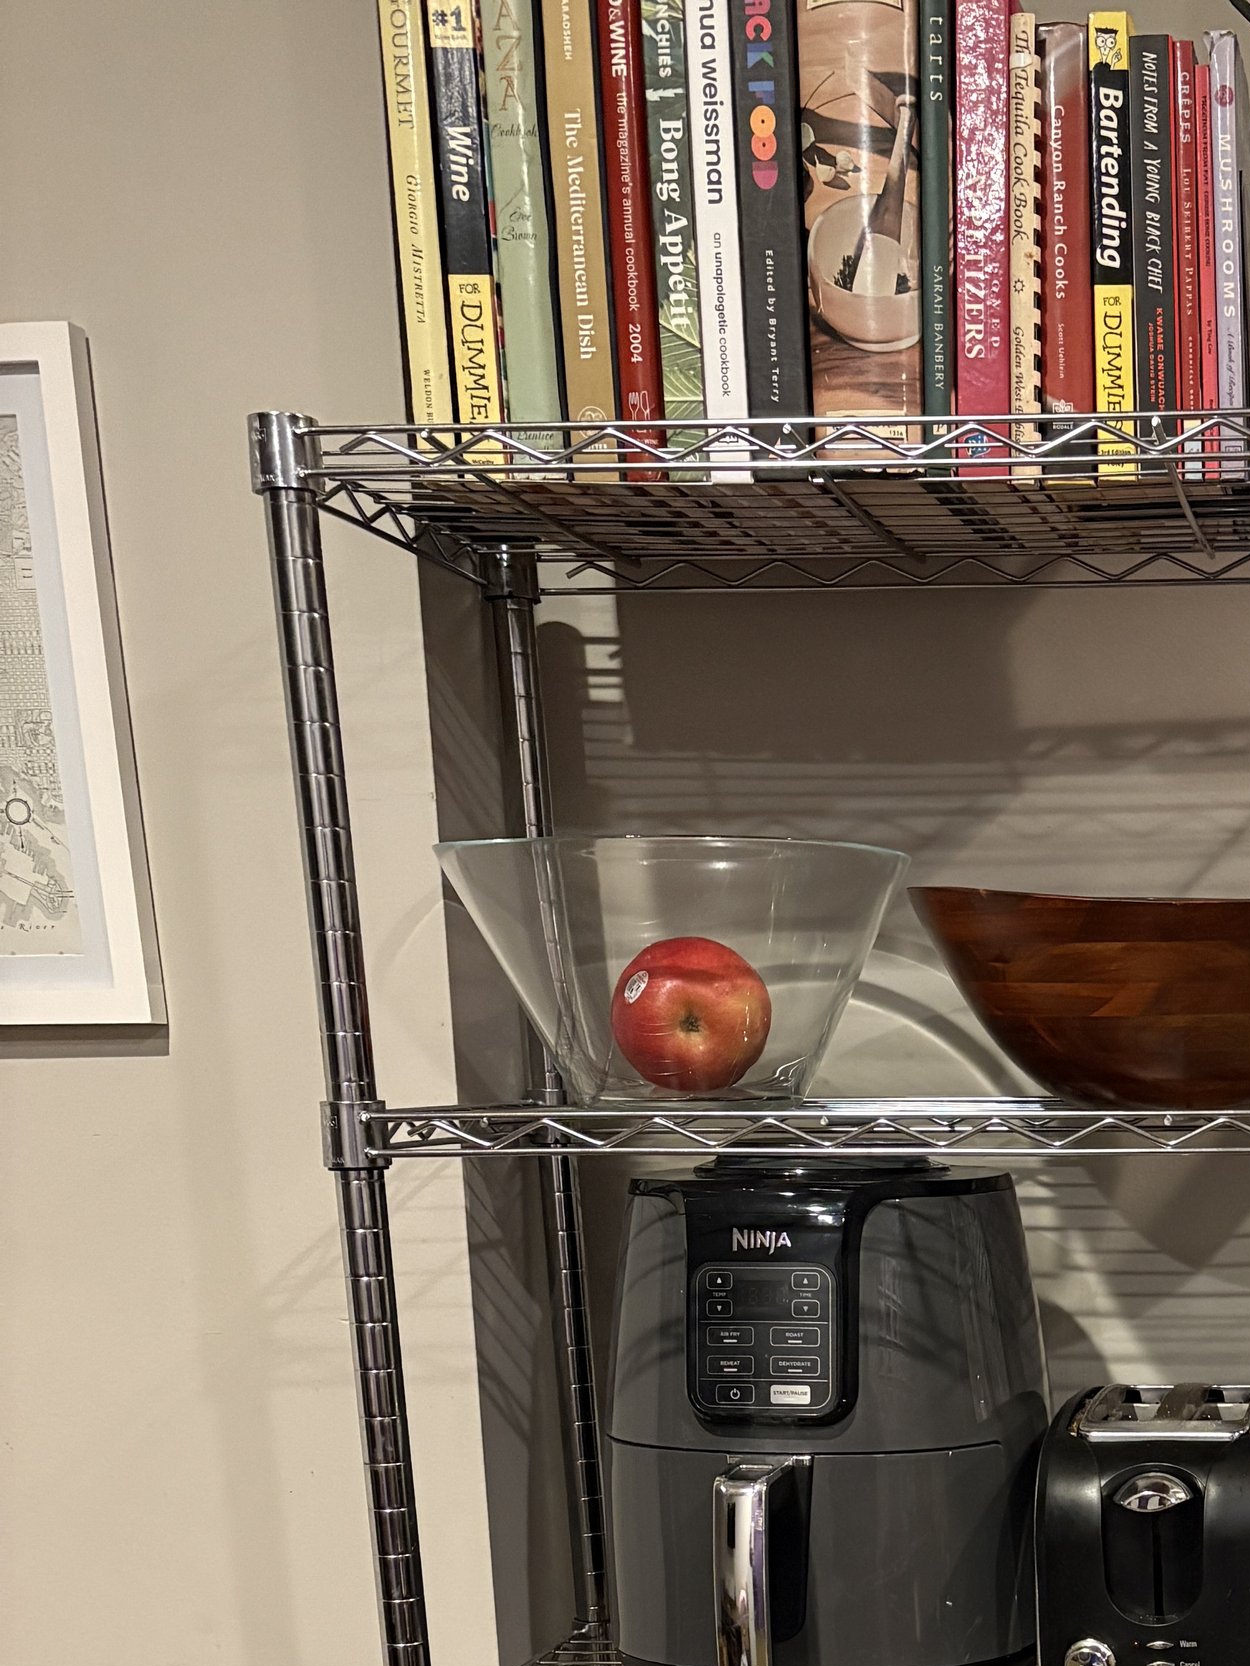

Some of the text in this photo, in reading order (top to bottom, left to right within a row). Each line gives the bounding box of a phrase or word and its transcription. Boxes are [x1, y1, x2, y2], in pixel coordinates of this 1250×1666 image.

[431, 5, 467, 32] #1
[561, 0, 572, 61] ARADSHEH
[1014, 30, 1031, 56] Th
[389, 0, 415, 130] OURMET
[929, 16, 944, 101] tarts
[1141, 51, 1158, 94] NOTES
[700, 58, 724, 205] weissman
[747, 80, 779, 191] FOOD
[1011, 67, 1031, 137] Tequila
[1143, 96, 1159, 134] FROM
[443, 125, 475, 202] Wine
[656, 118, 684, 202] Bong
[1096, 86, 1127, 269] Bartending
[1143, 159, 1161, 204] YOUNG
[564, 107, 597, 360] The Mediterranean Dish
[615, 91, 644, 363] the magazine's annual cookbook 2004
[1050, 104, 1069, 300] Canyon Ranch Cooks
[1144, 212, 1162, 255] BLACK
[1218, 134, 1236, 318] MUSHROOMS
[458, 283, 481, 295] FOR
[1103, 297, 1121, 307] FOR
[1146, 257, 1163, 294] CHEF
[713, 232, 731, 397] an unapologetic cookbook
[764, 249, 781, 403] Edited by Bryant Terry
[933, 265, 945, 390] SARAH BANBERY
[1013, 326, 1027, 369] Golden
[1057, 322, 1065, 344] Scott
[460, 300, 491, 424] DUMMIE
[1014, 372, 1026, 403] West
[1156, 307, 1165, 411] KWAME ONWUACH
[731, 1227, 792, 1256] NINJA
[1180, 1640, 1198, 1648] Warm
